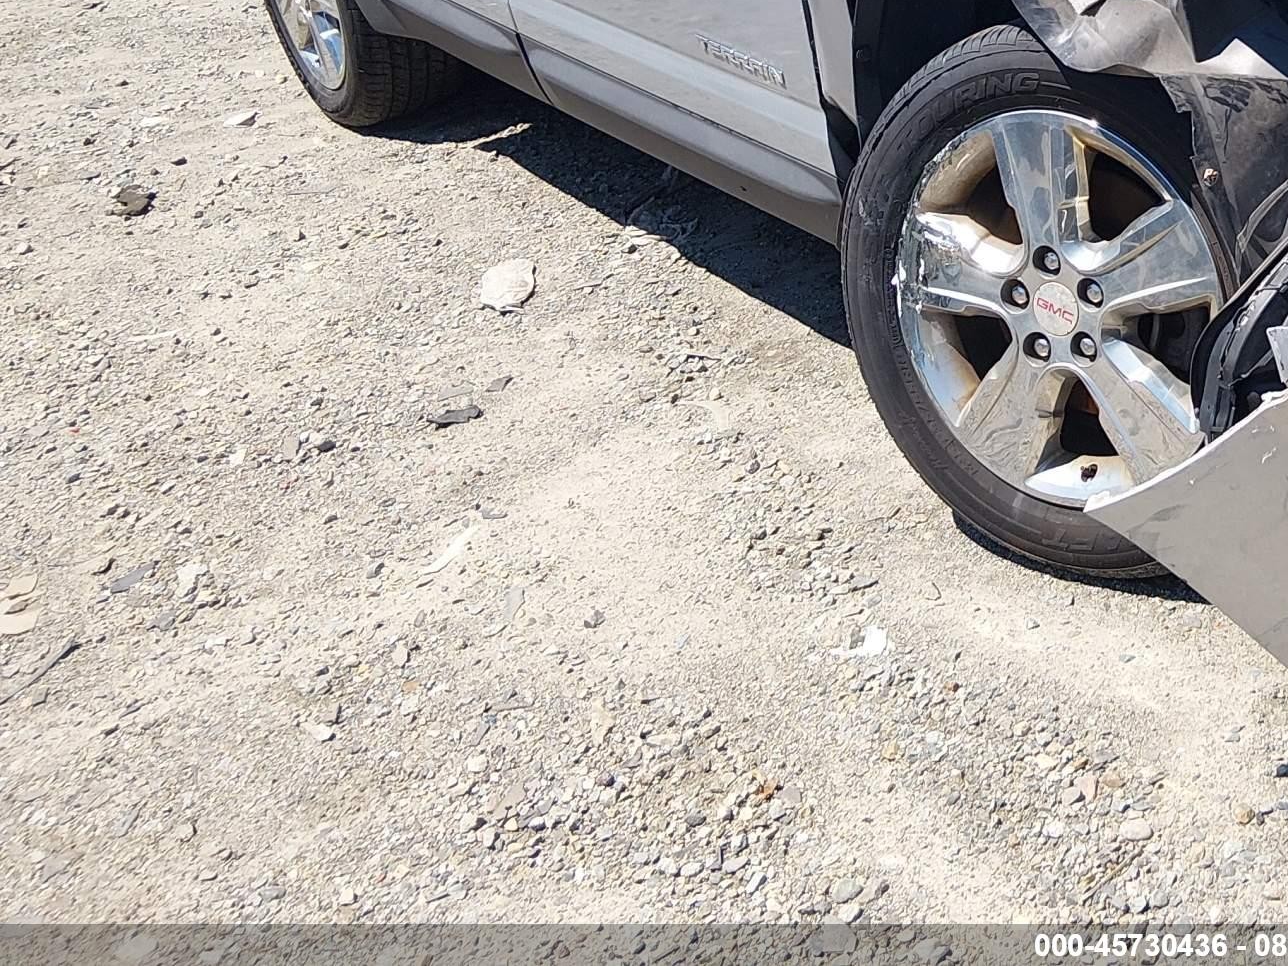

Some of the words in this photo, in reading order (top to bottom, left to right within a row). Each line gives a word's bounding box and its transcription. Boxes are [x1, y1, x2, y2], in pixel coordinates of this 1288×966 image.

[695, 33, 787, 90] TERRAIN
[896, 72, 1040, 152] TOURING
[1035, 296, 1075, 325] GMC
